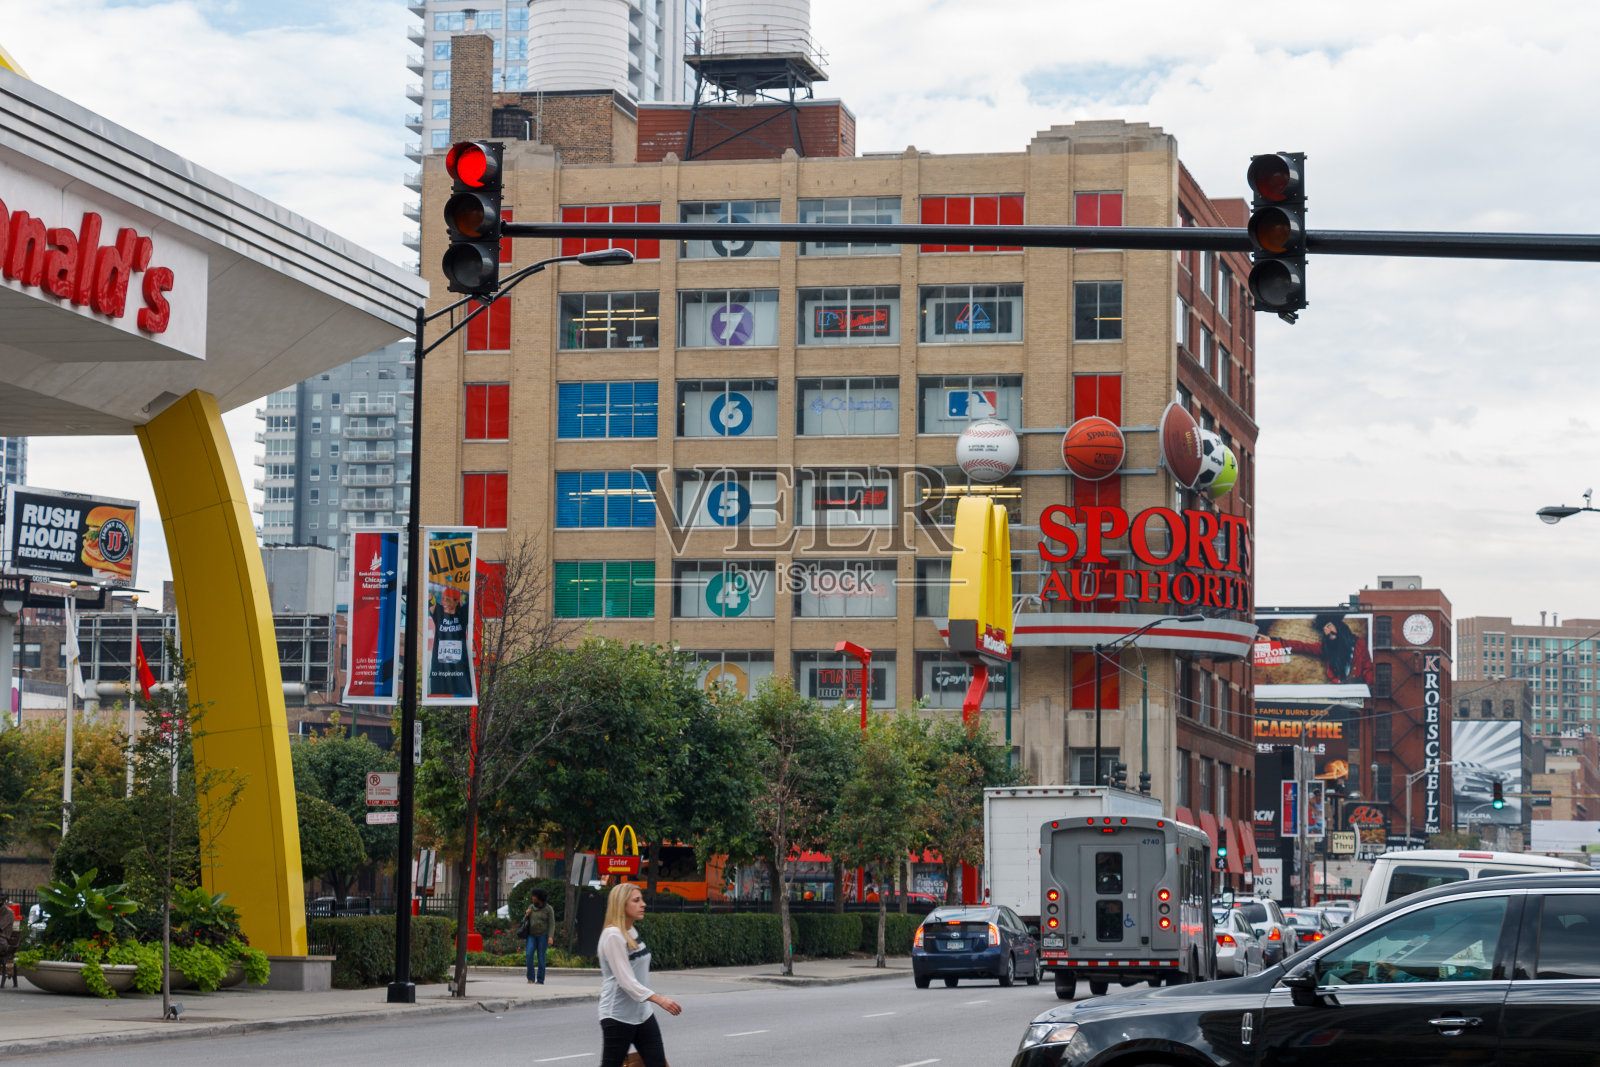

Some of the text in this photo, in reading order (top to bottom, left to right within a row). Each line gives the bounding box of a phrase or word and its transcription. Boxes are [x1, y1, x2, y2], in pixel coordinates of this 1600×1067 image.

[0, 197, 174, 334] nald's
[719, 312, 744, 340] 7
[718, 402, 743, 428] 6
[826, 397, 893, 410] Columbia
[22, 503, 81, 530] RUSH
[718, 491, 741, 517] 5
[19, 525, 78, 551] HOUR
[18, 546, 75, 563] REDEFINED!
[716, 582, 741, 609] 4
[1285, 708, 1309, 716] BURNS
[1254, 719, 1302, 738] ICAGO
[1424, 655, 1440, 822] KROESCHELL
